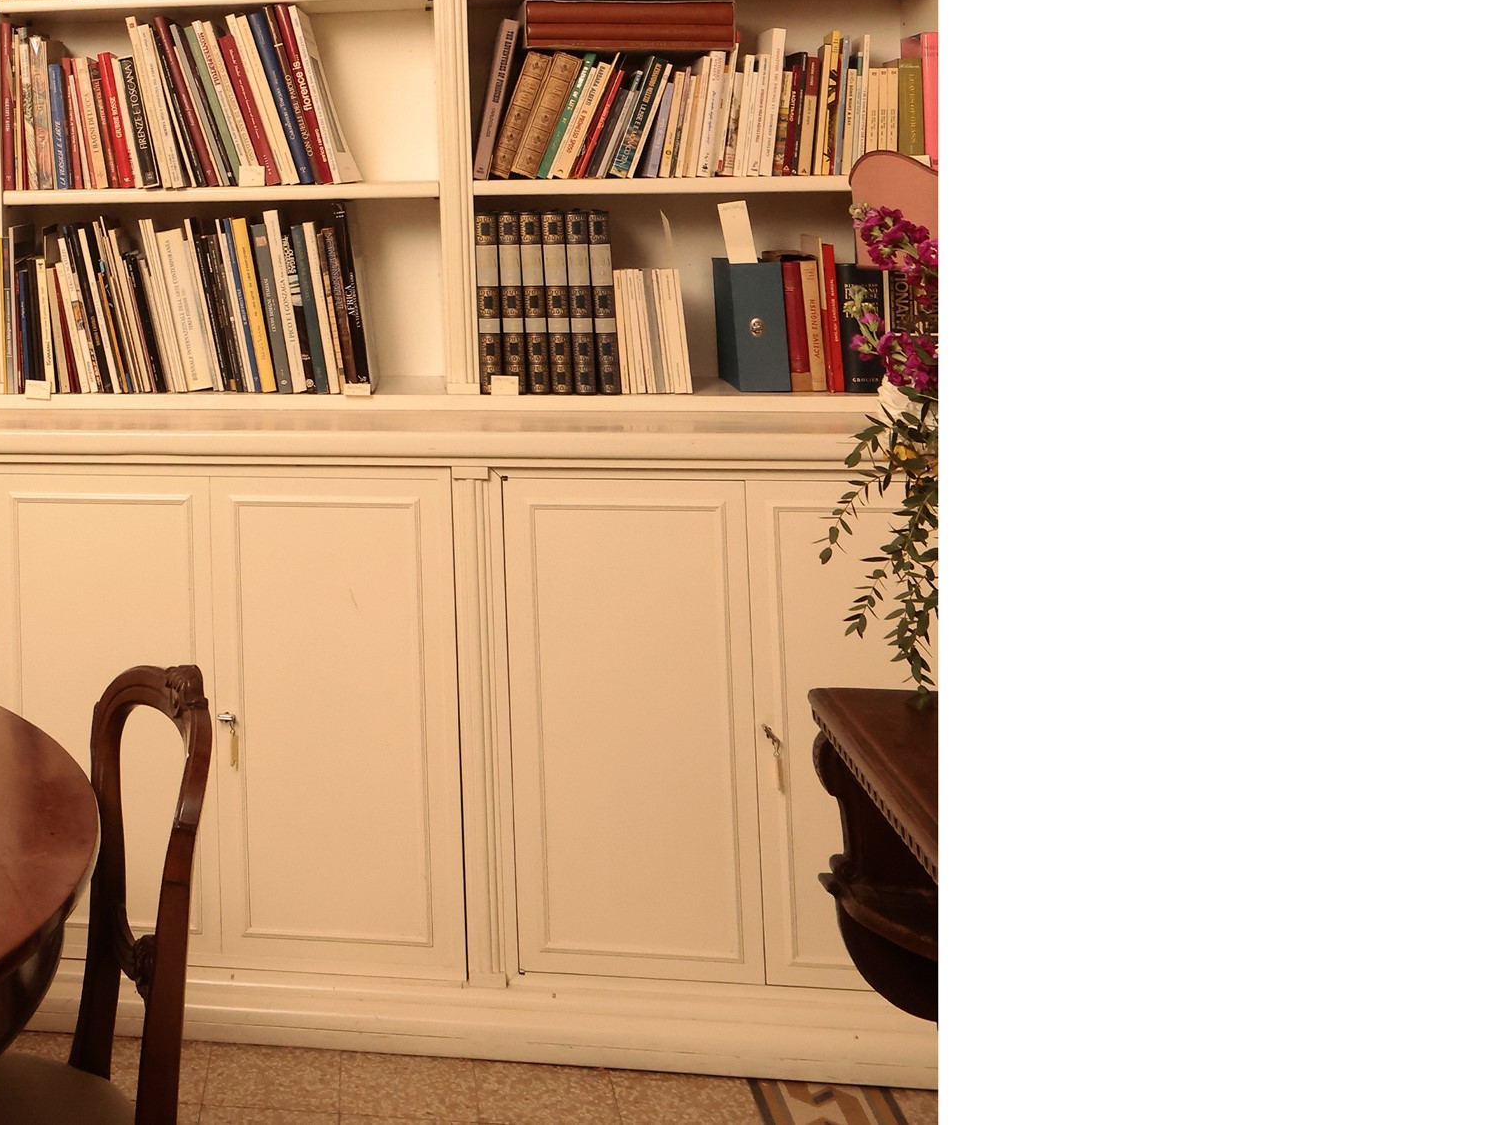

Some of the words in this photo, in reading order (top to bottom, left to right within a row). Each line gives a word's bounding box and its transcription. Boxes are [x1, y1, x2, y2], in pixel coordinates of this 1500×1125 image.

[506, 31, 514, 40] THE
[198, 32, 220, 86] MONTESPERTOLI
[292, 54, 302, 70] is...
[498, 41, 513, 71] ADVENTURES
[123, 65, 140, 107] TOSCANA
[285, 74, 297, 99] PAIOLO
[591, 66, 606, 87] BARBARA
[297, 71, 313, 111] florence
[492, 79, 504, 103] PINOCCHIO
[585, 88, 596, 106] ALBERTI
[84, 92, 93, 116] LUCCA
[109, 96, 119, 115] ROSSE
[292, 100, 301, 114] DEL
[910, 104, 915, 115] OF
[54, 120, 62, 141] L'ARTE
[89, 126, 99, 149] BAGNI
[113, 116, 123, 138] GIUBBE
[134, 117, 148, 149] FIRENZE
[297, 115, 309, 139] QUELLI
[314, 128, 323, 145] rainero
[571, 115, 586, 138] PROMESSO
[304, 140, 314, 157] CON
[318, 146, 328, 162] enrico
[566, 139, 576, 154] SPOSO
[56, 150, 66, 176] VERSILIA
[60, 178, 66, 186] LA
[165, 239, 178, 284] CONTEMPORANEA
[174, 285, 185, 312] DELL'ARTE
[280, 279, 291, 312] GONZAGA
[345, 285, 355, 316] AFRICA
[809, 299, 818, 331] ENGLISH
[179, 313, 194, 355] INTERNAZIONALE
[286, 322, 295, 338] PICO
[188, 356, 198, 381] BIENNALE
